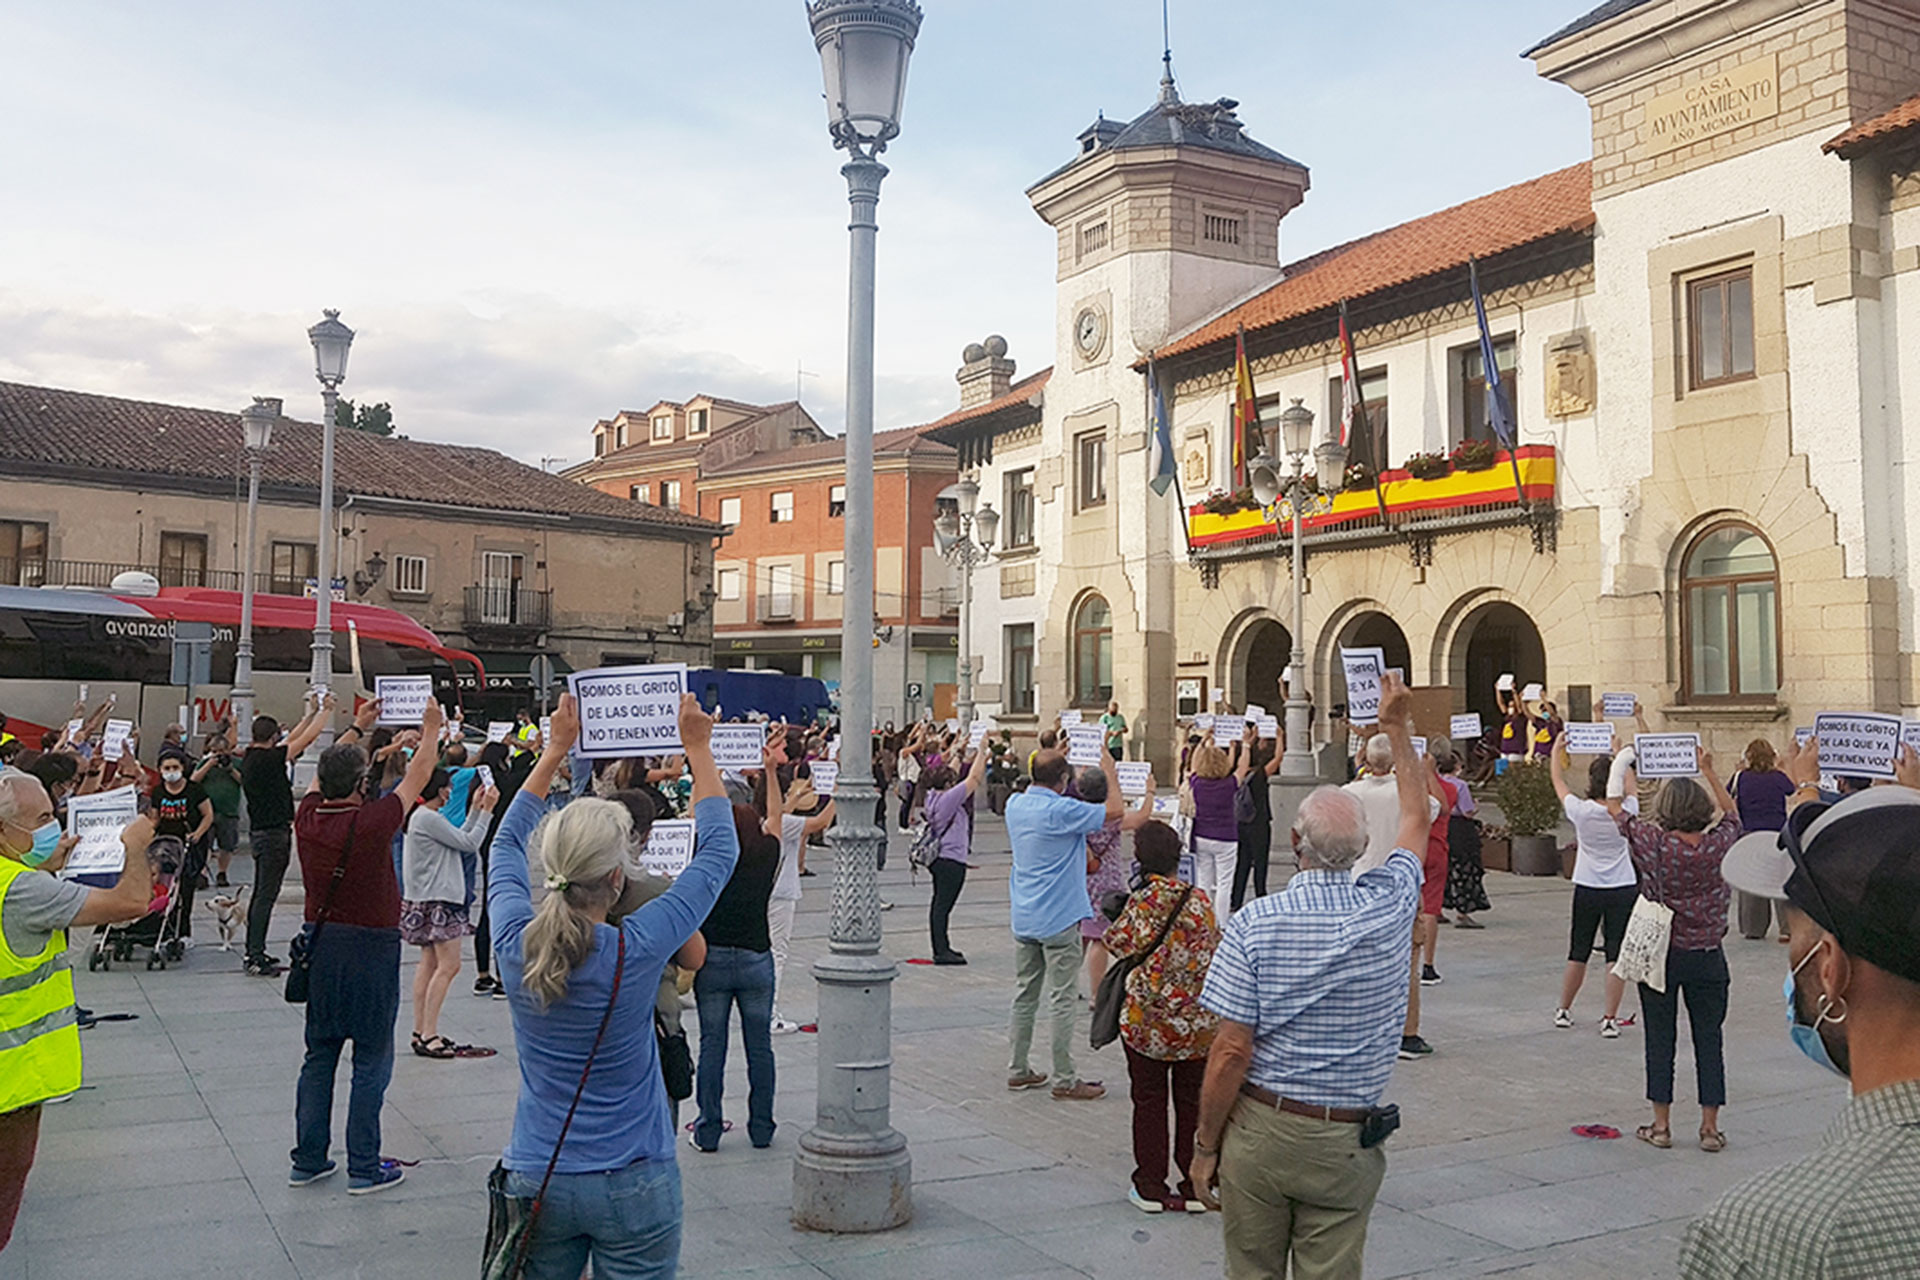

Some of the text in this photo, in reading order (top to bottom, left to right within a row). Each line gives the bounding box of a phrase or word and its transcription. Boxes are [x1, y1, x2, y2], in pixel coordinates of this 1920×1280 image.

[1685, 77, 1731, 101] CASA
[1651, 79, 1771, 136] AYVNTAMIENTO
[581, 681, 678, 698] SOMOS EL GRITO
[1359, 680, 1376, 691] YA
[587, 704, 675, 719] DE LAS QUE YA
[1357, 698, 1379, 710] VOZ
[588, 725, 676, 741] NO TIENEN VOZ
[1819, 721, 1897, 736] SOMOS EL GRITO
[1832, 738, 1850, 748] LAS
[1852, 740, 1873, 750] QUE
[1875, 741, 1890, 751] YA
[1831, 753, 1865, 765] TIENEN
[1867, 756, 1889, 767] VOZ
